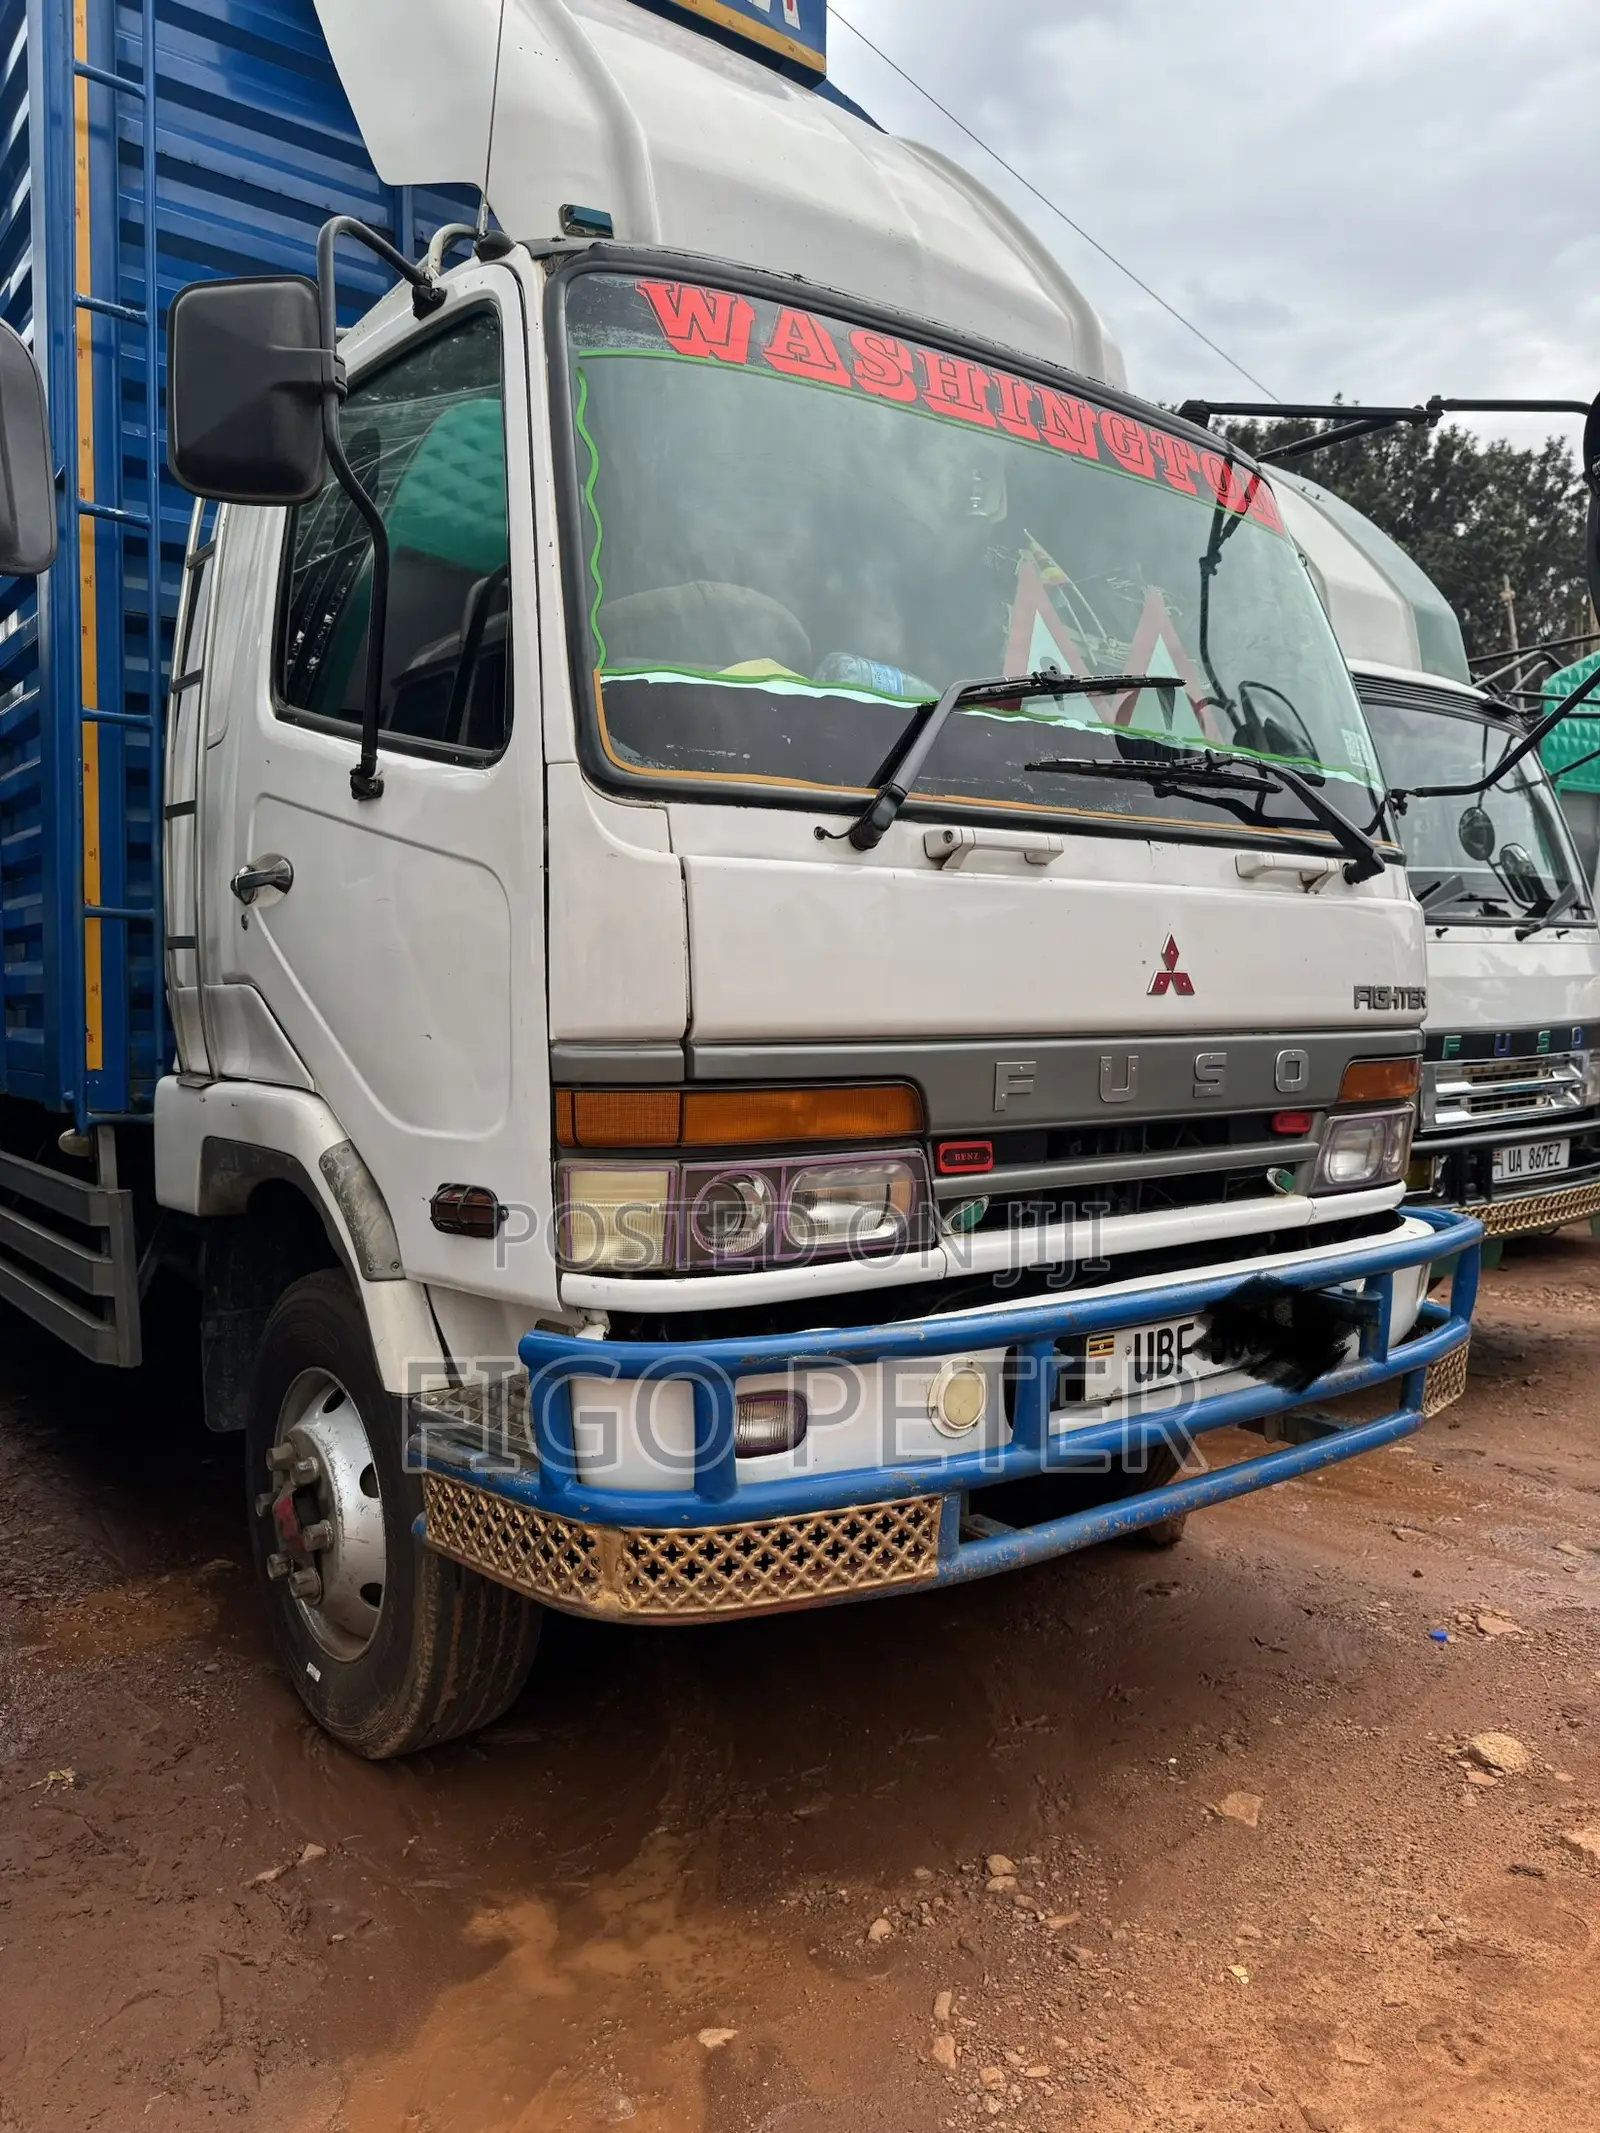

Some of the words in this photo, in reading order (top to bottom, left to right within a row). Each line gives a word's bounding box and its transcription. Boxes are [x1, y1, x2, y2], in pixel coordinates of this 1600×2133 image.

[635, 279, 1286, 537] WASHINGTON
[1353, 986, 1427, 1010] FIGHTER
[1442, 1026, 1583, 1060] FUSO
[994, 1049, 1310, 1112] FUSO
[954, 1152, 980, 1161] BENZ
[1508, 1149, 1522, 1173] UA
[1528, 1143, 1561, 1170] 867EZ
